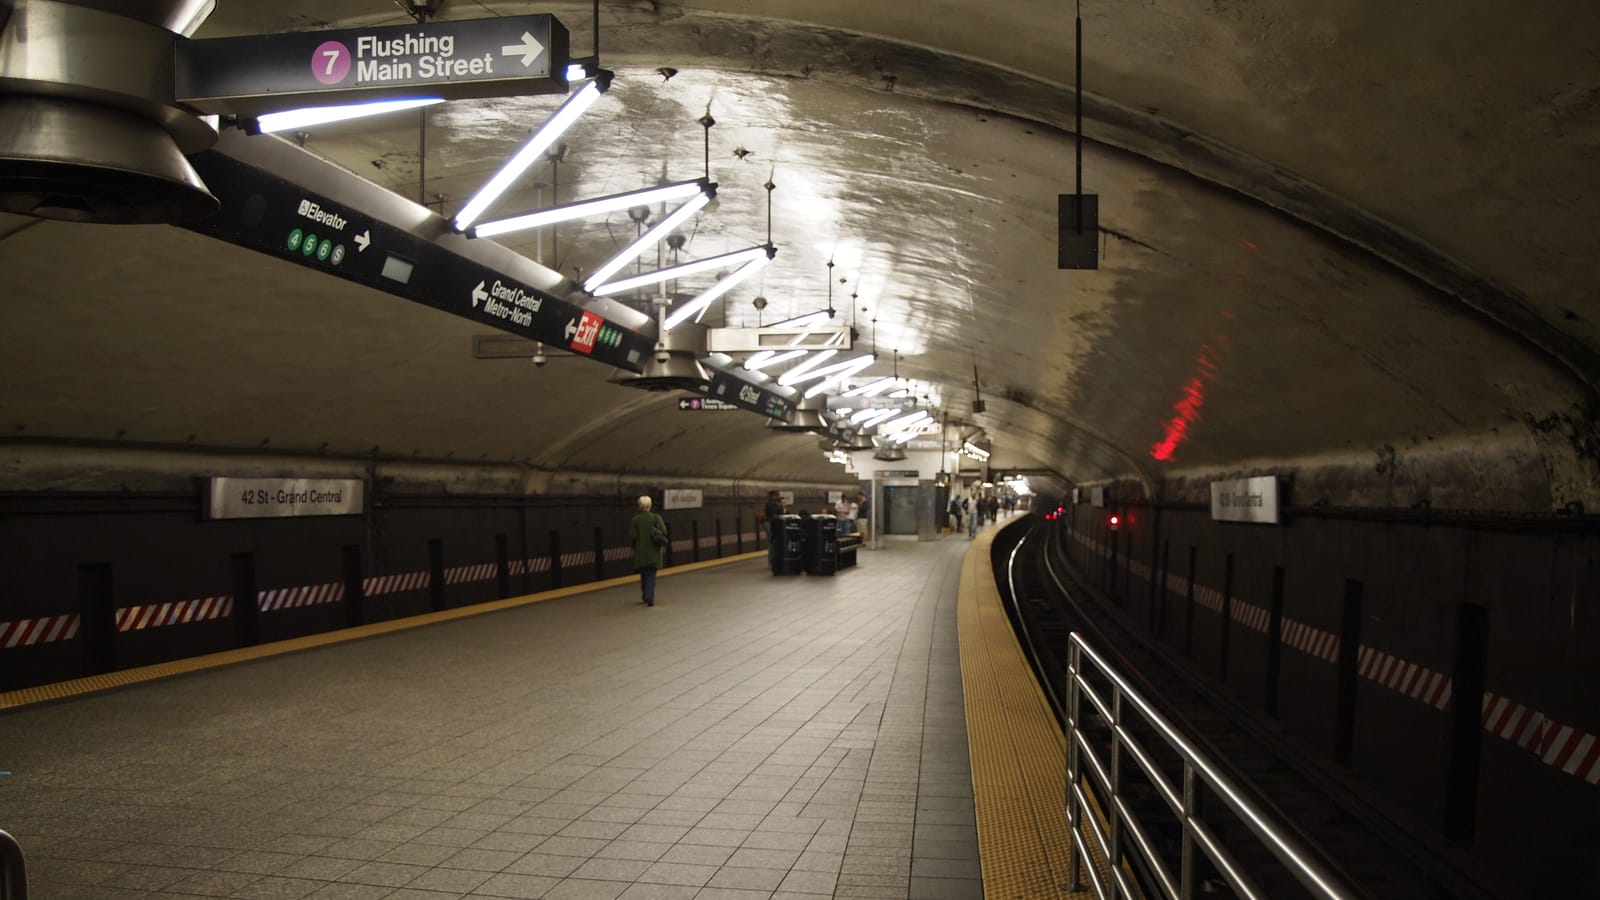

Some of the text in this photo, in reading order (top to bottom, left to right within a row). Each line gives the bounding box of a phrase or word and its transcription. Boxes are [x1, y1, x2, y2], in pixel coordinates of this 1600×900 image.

[323, 33, 454, 75] 7 Flushing
[357, 53, 493, 82] Main Street
[306, 203, 348, 231] Elevator
[291, 233, 343, 262] 4 5 6 S
[492, 280, 542, 313] Grand Central
[484, 297, 533, 327] Metro-North
[573, 316, 599, 346] Exit
[241, 490, 254, 504] 42
[257, 490, 269, 504] St
[277, 489, 307, 504] Grand
[309, 489, 342, 503] Central
